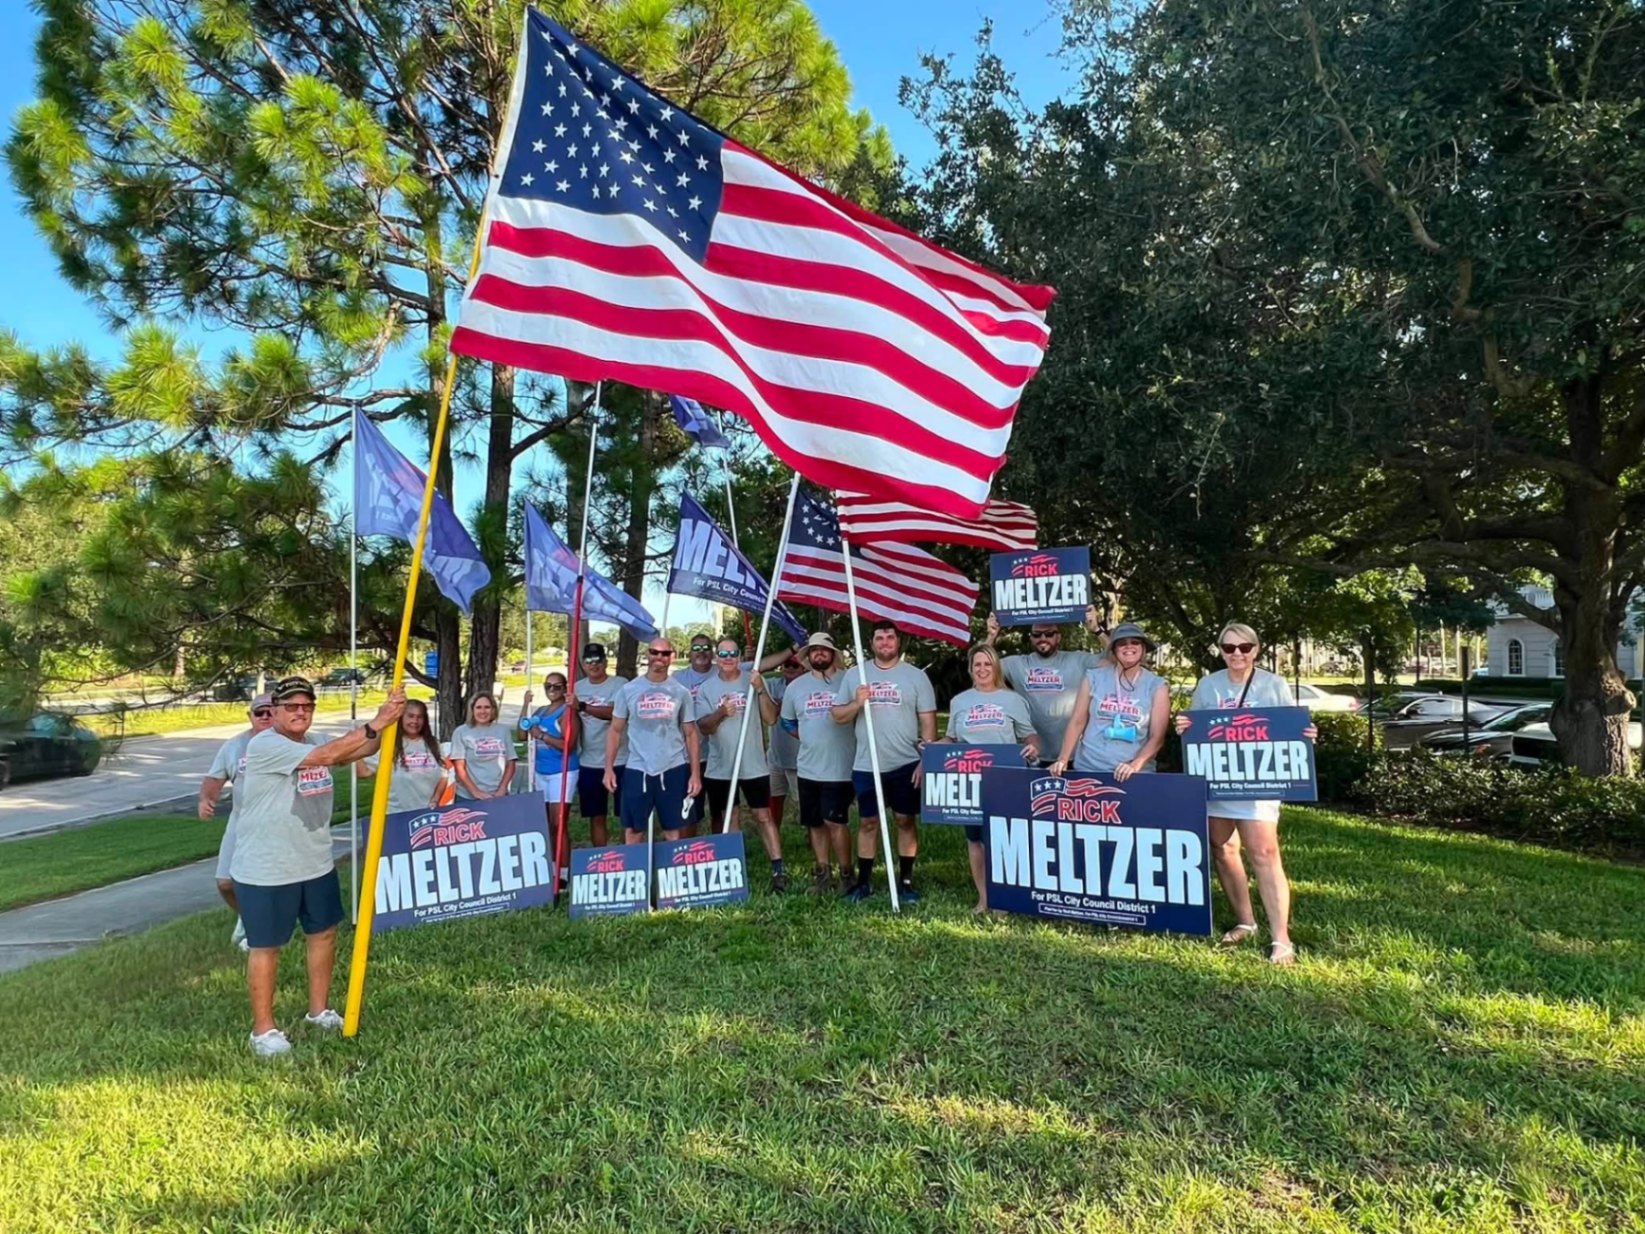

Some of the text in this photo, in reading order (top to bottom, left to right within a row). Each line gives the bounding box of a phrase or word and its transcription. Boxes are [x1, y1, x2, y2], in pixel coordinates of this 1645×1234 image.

[1024, 563, 1058, 576] RICK
[693, 577, 705, 586] For
[706, 580, 720, 590] PSL
[722, 584, 738, 596] City
[995, 574, 1088, 610] MELTZER
[1100, 702, 1139, 714] MELZER
[1225, 726, 1270, 741] RICK
[1186, 740, 1310, 781] MELTZER
[926, 772, 982, 808] MELT
[1058, 798, 1122, 824] RICK
[433, 821, 486, 846] RICK
[598, 860, 624, 872] RICK
[685, 850, 715, 864] RICK
[990, 816, 1204, 906] MELTZER
[375, 832, 550, 914] MELTZER
[657, 858, 744, 899] MELTZER
[572, 870, 646, 905] MELTZER
[414, 909, 427, 918] For
[428, 906, 442, 915] PSL
[443, 904, 458, 913] City
[459, 898, 485, 909] Council
[486, 894, 511, 904] District
[1031, 891, 1044, 900] For
[1046, 893, 1062, 903] PSL
[1064, 895, 1080, 907] City
[1082, 897, 1115, 910] Council
[1117, 901, 1149, 913] District
[1150, 904, 1156, 914] 1
